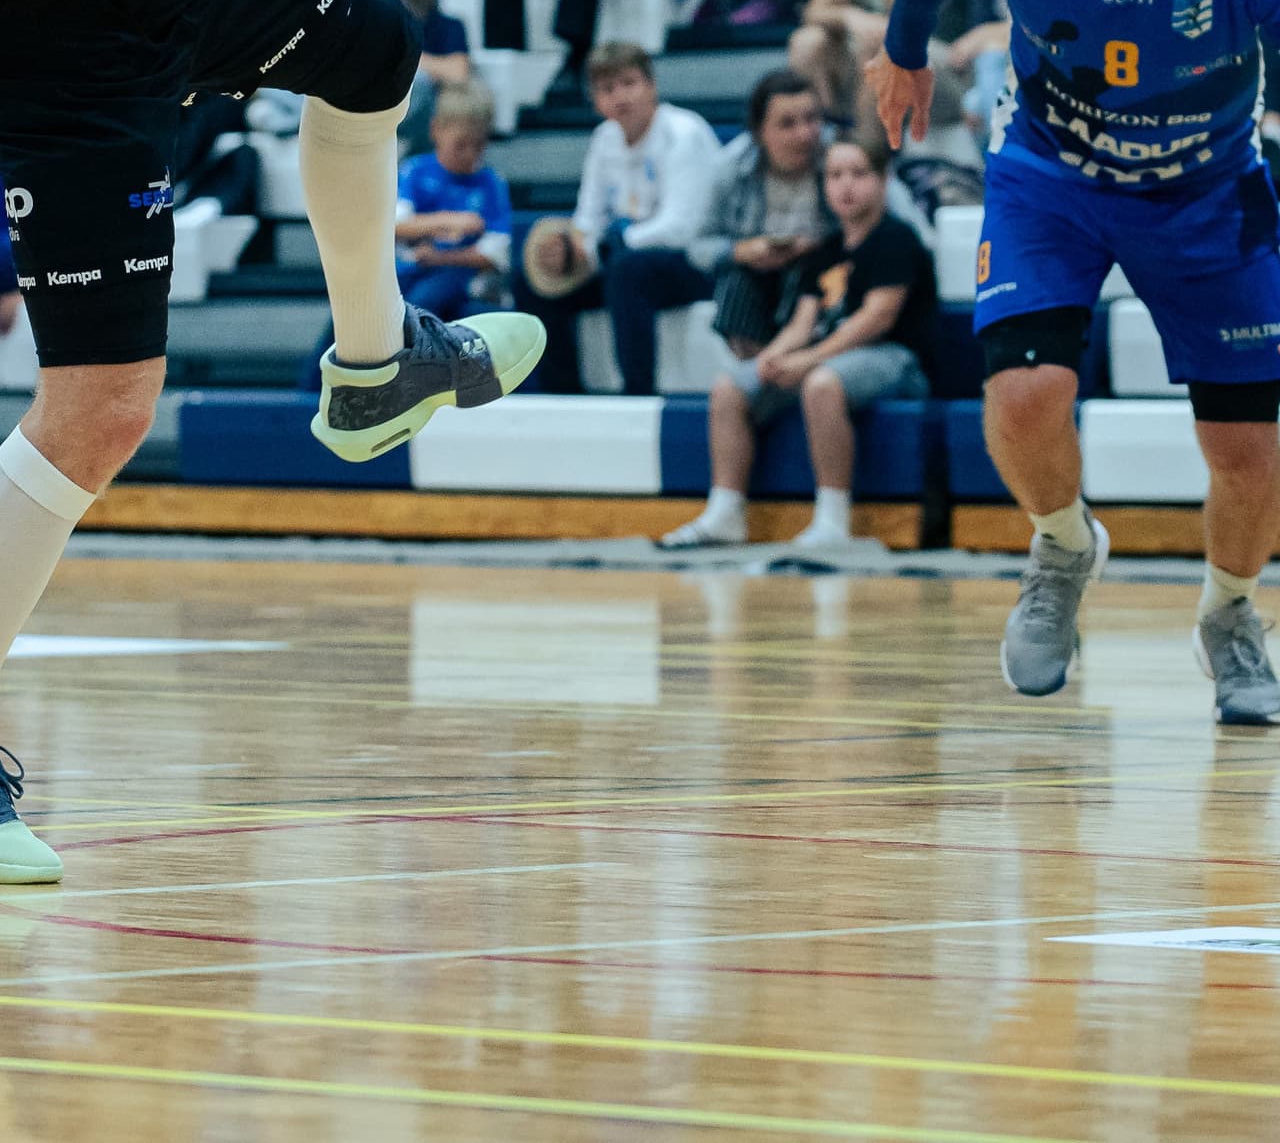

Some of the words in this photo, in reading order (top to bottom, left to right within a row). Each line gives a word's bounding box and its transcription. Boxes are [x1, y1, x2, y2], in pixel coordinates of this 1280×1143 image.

[258, 28, 306, 75] Kempa
[1104, 39, 1139, 88] 8
[46, 268, 102, 286] Kempa
[123, 255, 169, 274] Kempa
[976, 240, 992, 285] 8
